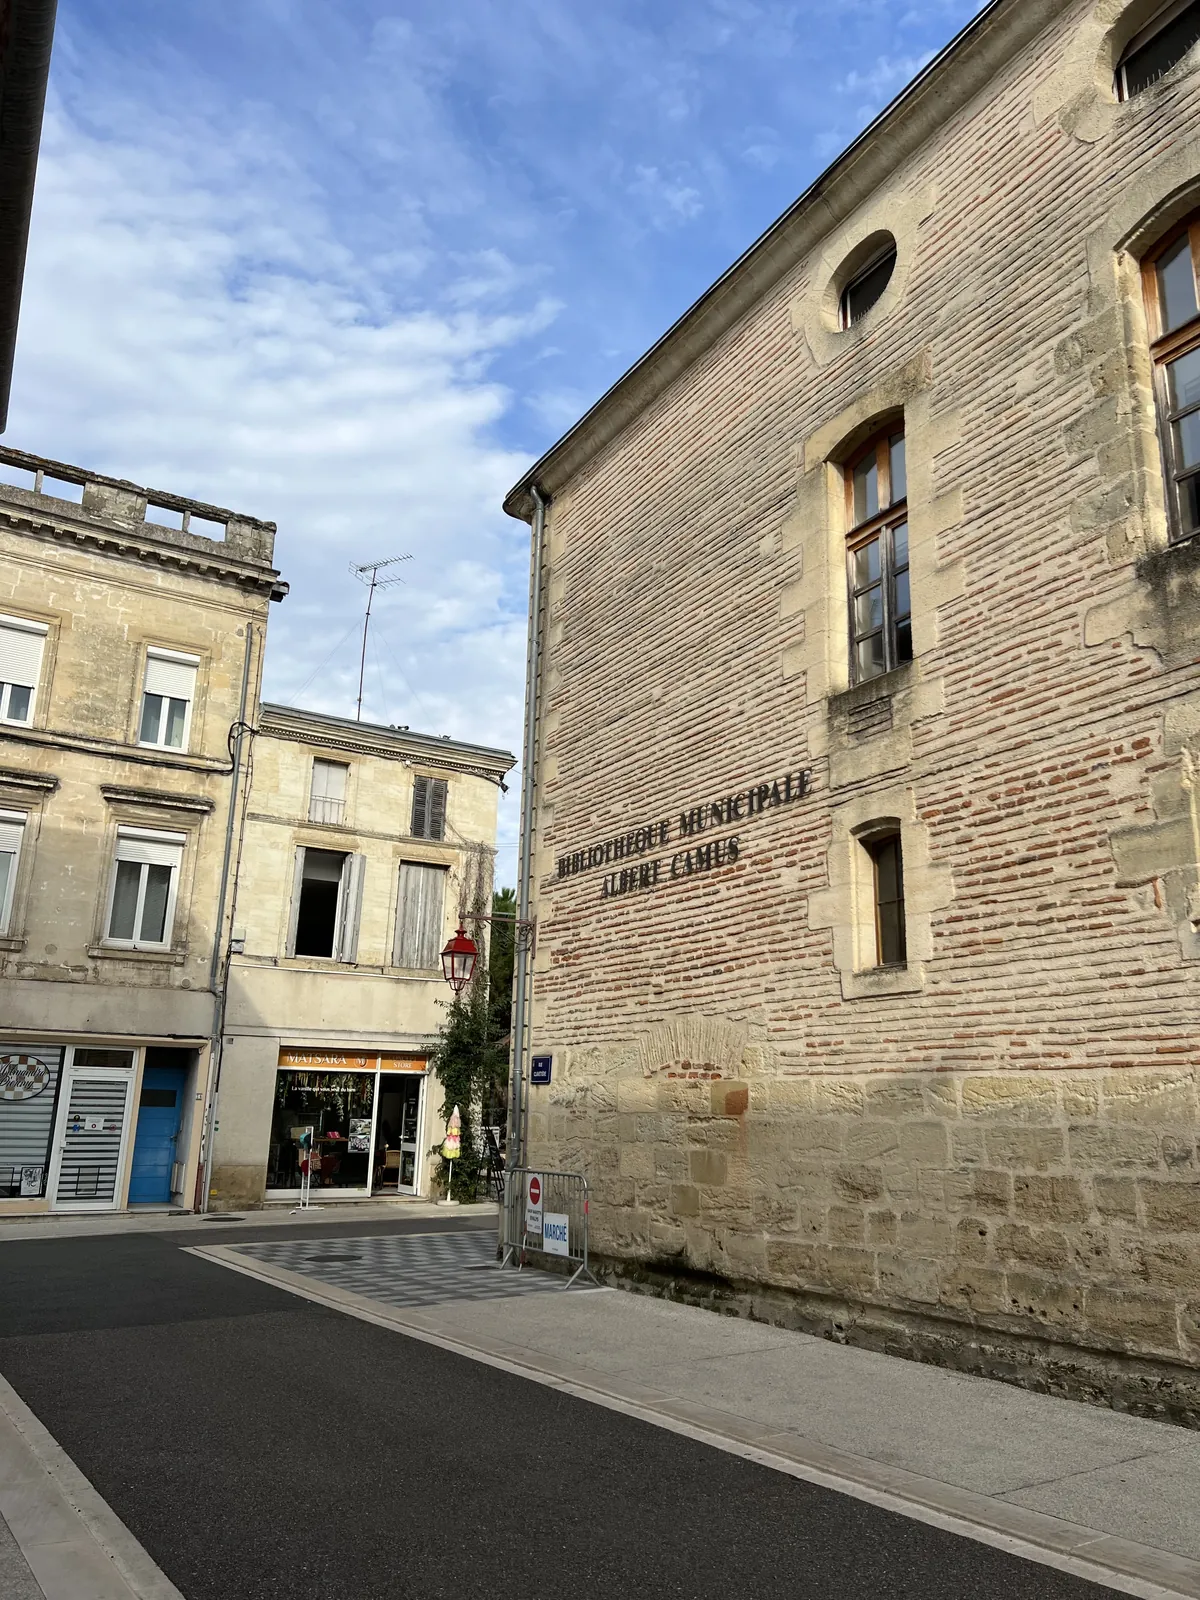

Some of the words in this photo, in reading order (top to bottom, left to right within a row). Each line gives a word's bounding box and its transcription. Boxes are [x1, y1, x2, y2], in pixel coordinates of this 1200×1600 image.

[678, 767, 813, 837] MUNICIPALE
[600, 858, 662, 898] ALBERT
[669, 834, 741, 879] CAMUS
[286, 1052, 347, 1065] MATSARA
[544, 1222, 567, 1242] MARCHÉ
